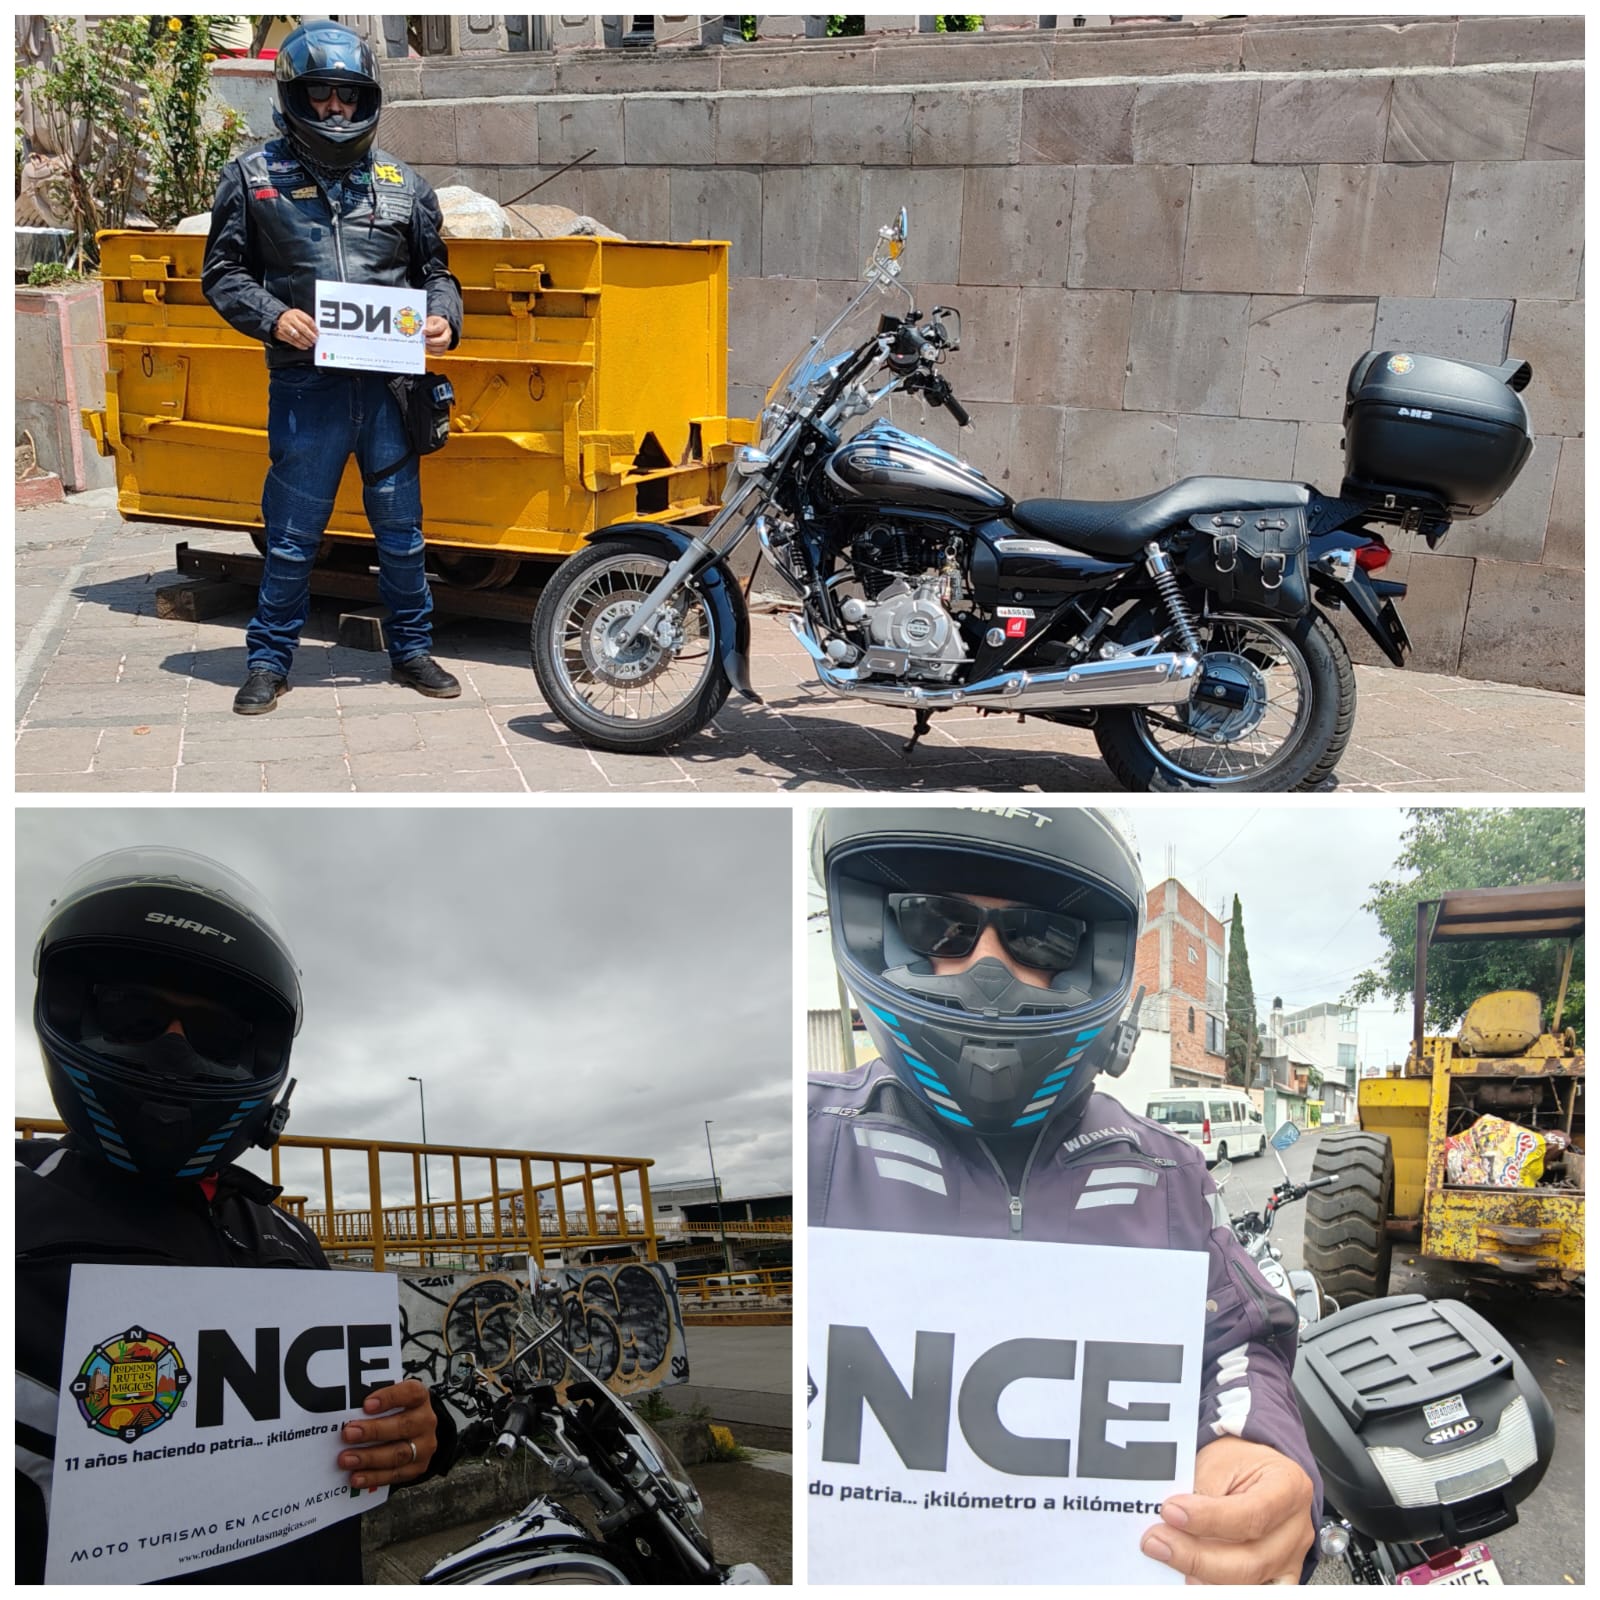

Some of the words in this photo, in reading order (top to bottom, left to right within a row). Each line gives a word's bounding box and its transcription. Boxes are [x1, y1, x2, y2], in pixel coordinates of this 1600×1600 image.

[145, 912, 237, 944] SHAFT
[196, 1324, 393, 1428] NCE
[821, 1324, 1184, 1481] NCE
[65, 1457, 80, 1471] 11
[84, 1453, 128, 1469] años
[132, 1441, 206, 1463] haciendo
[209, 1435, 263, 1455] patria...
[266, 1426, 328, 1447] ¡kilómetro
[331, 1424, 338, 1432] a
[1430, 1420, 1478, 1444] SHAD
[840, 1485, 917, 1505] patria...
[924, 1491, 1037, 1510] ¡kilómetro
[1043, 1498, 1056, 1510] a
[71, 1542, 128, 1563] MOTO
[138, 1523, 218, 1549] TURISMO
[225, 1517, 246, 1531] EN
[252, 1502, 300, 1525] ACCIÓN
[178, 1516, 317, 1563] www.rodandorutasmagicas.com
